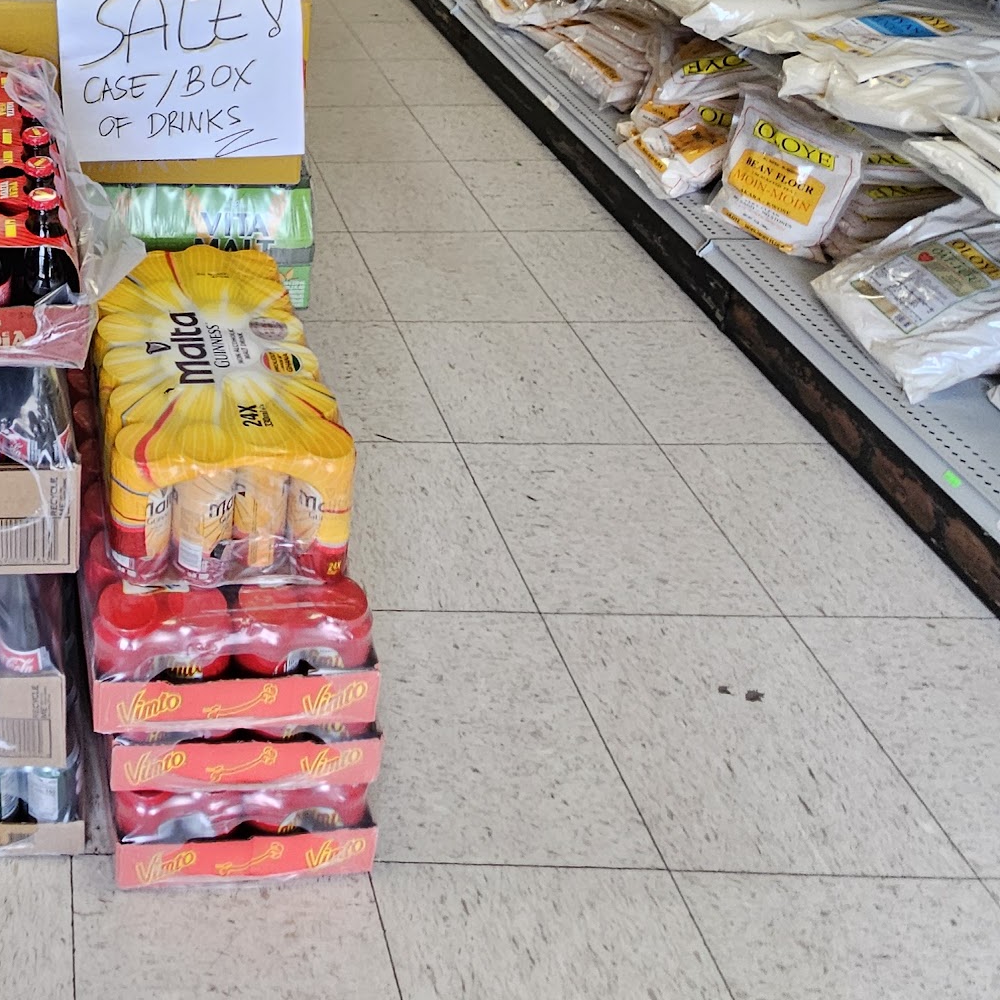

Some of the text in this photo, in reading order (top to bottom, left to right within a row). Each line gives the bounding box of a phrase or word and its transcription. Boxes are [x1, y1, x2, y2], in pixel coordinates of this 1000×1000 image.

[99, 106, 241, 139] OF DRINKS
[757, 123, 832, 167] OOYE
[746, 157, 773, 176] BEAN
[201, 212, 269, 237] VITA
[169, 311, 216, 385] Malta
[209, 323, 231, 369] GUINNESS
[237, 404, 262, 428] 24X
[116, 689, 182, 725] Vimto
[302, 680, 368, 716] Vimto
[124, 747, 187, 785] Vimto
[300, 746, 363, 779] Vimto
[136, 850, 197, 886] Vimto
[306, 837, 366, 870] Vimto
